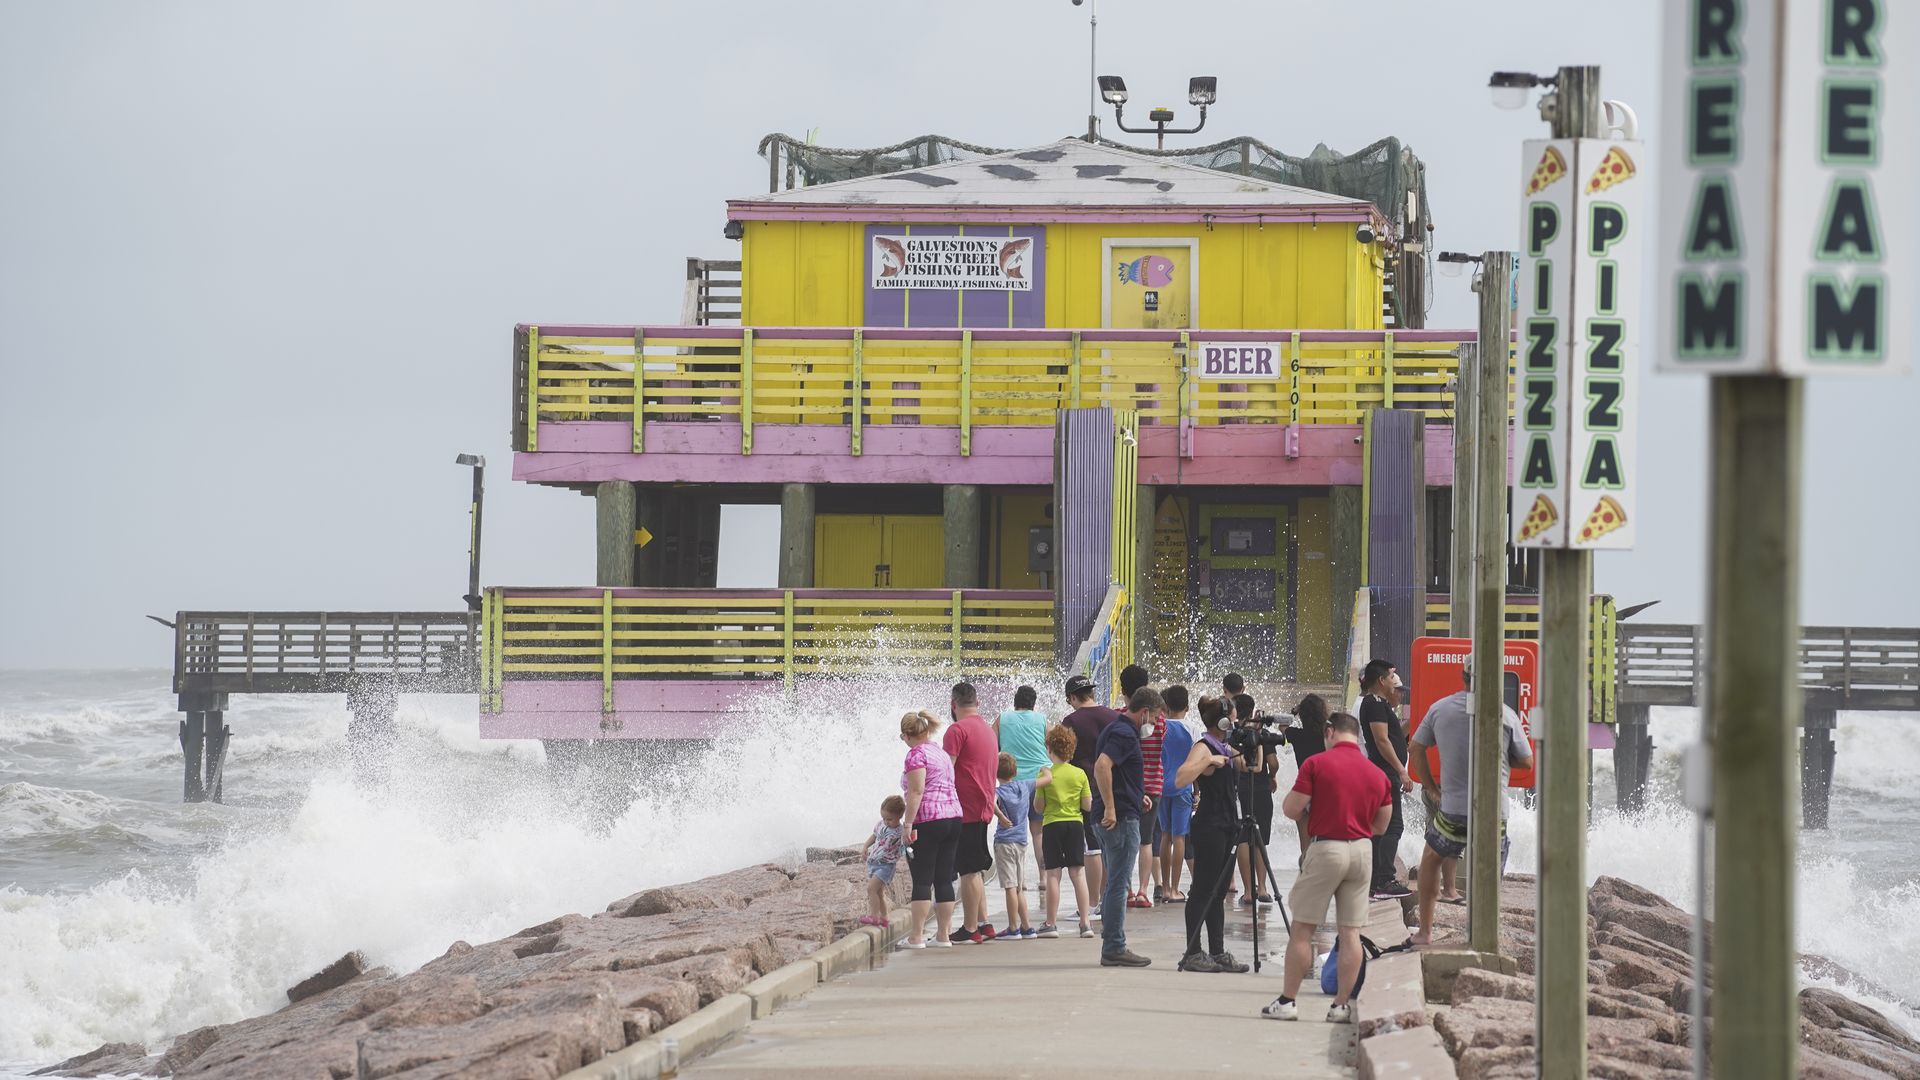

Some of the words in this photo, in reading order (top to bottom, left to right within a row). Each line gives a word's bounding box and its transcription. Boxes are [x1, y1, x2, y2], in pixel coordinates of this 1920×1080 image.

[907, 240, 998, 252] GALVESTON'S
[908, 252, 940, 264] 61ST
[945, 253, 997, 265] STREET
[904, 264, 961, 276] FISHING
[967, 265, 999, 277] PIER
[1520, 200, 1561, 489] PIZZA
[1580, 200, 1628, 490] PIZZA
[1205, 347, 1273, 375] BEER
[1290, 359, 1300, 422] 6101
